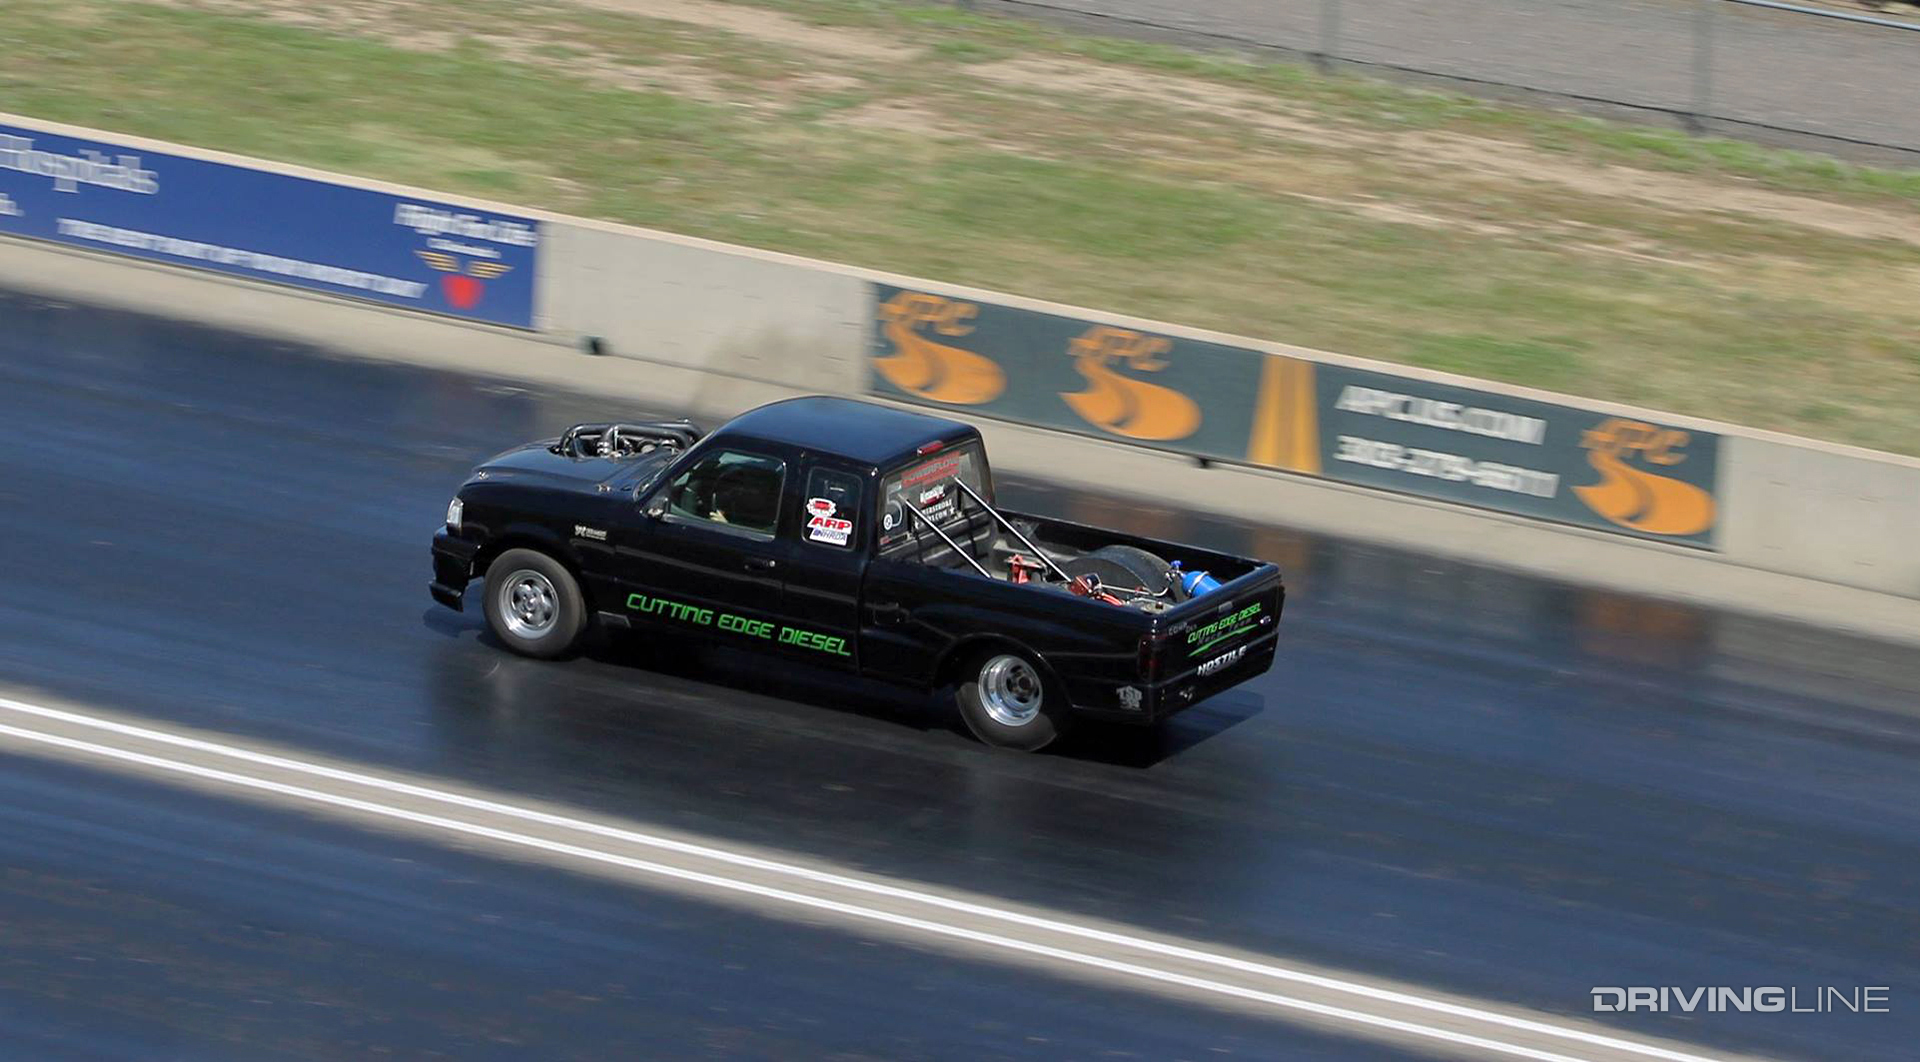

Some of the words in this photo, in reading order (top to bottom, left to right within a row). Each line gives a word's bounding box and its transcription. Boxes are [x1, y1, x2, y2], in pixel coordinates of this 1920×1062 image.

[811, 517, 851, 531] ARP
[626, 593, 714, 625] CUTTING
[717, 614, 775, 639] EDGE
[779, 626, 852, 656] DIESEL
[1187, 621, 1219, 644] CUTTING
[1218, 612, 1239, 630] EDGE
[1239, 602, 1262, 621] DIESEL
